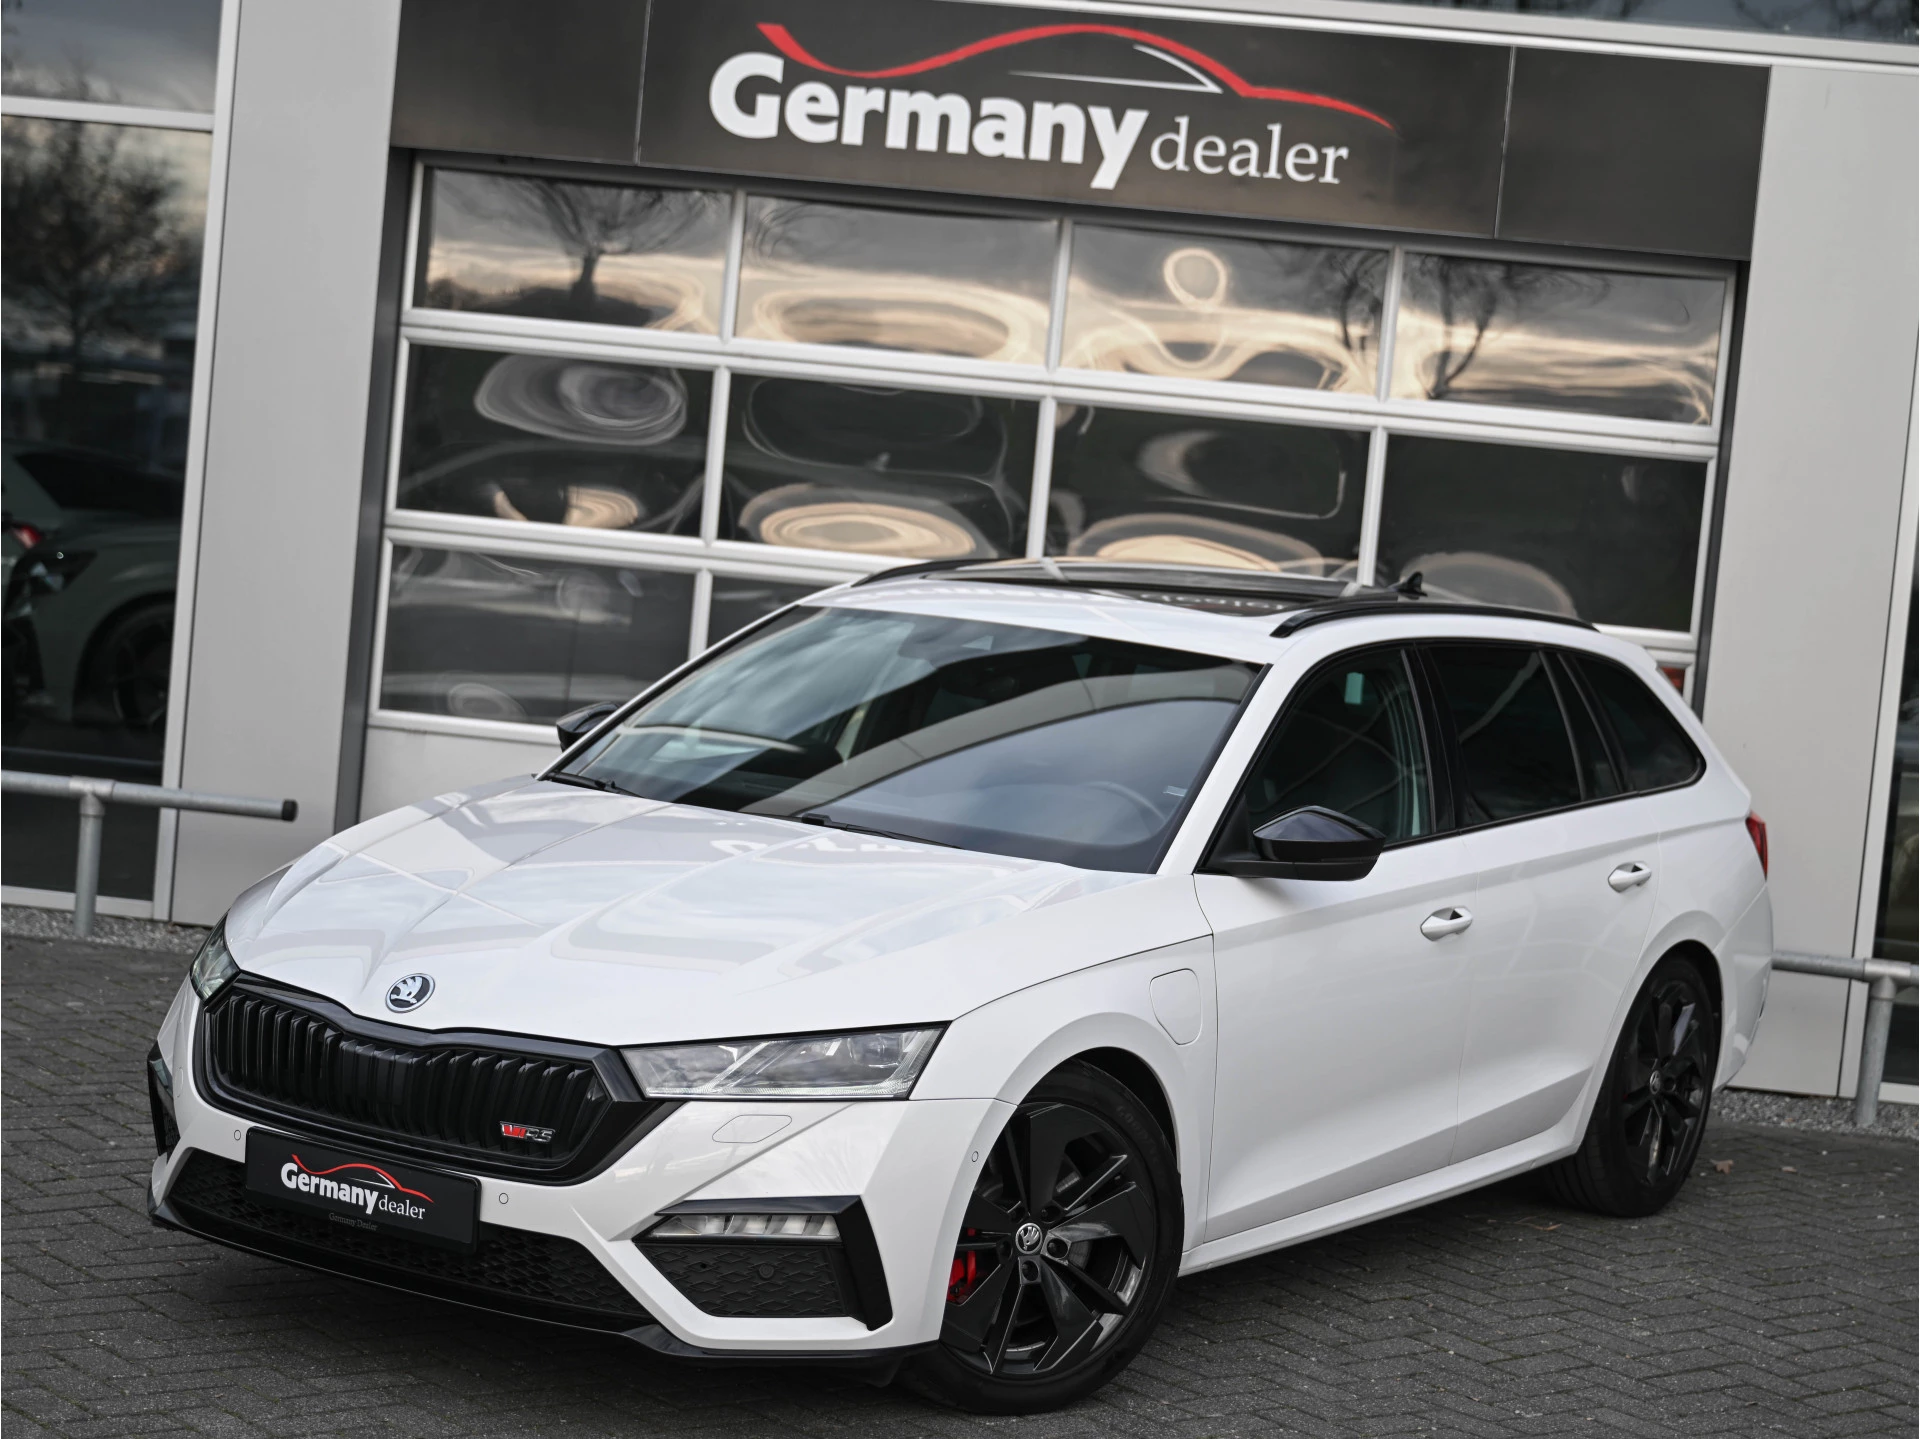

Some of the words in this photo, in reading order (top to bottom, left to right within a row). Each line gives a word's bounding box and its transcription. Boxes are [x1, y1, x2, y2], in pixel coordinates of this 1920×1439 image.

[709, 52, 1148, 189] Germany
[1150, 116, 1349, 184] dealer
[281, 1162, 379, 1215] Germany
[378, 1195, 425, 1220] dealer
